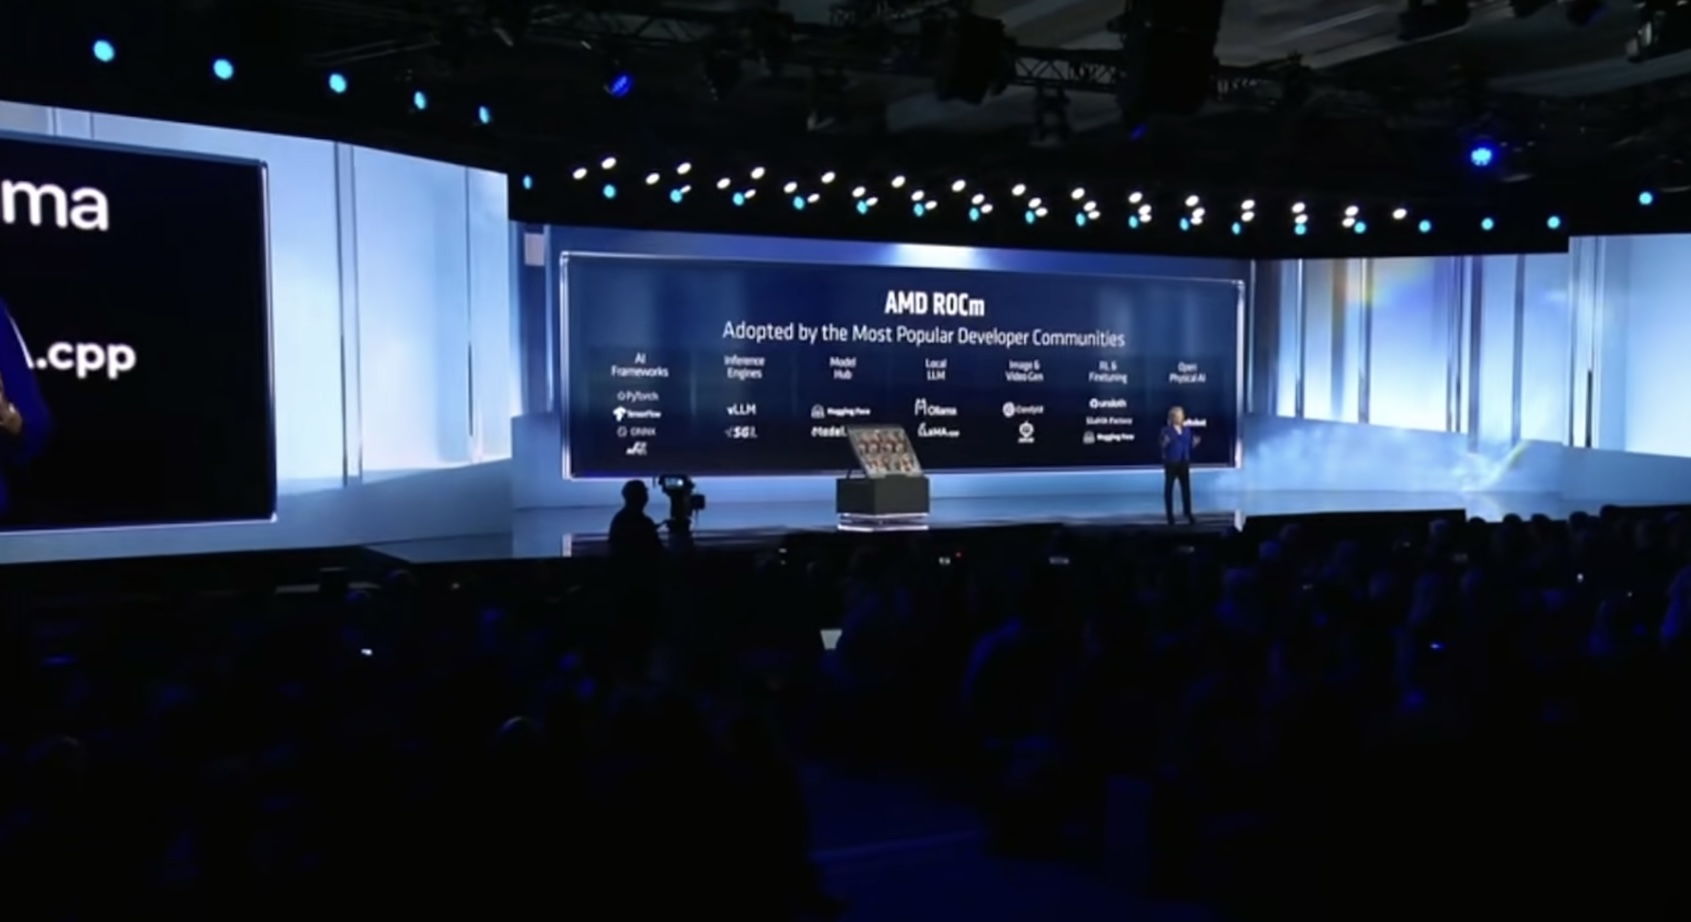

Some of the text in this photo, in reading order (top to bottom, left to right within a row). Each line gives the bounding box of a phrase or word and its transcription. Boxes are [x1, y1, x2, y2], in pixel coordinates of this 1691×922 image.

[884, 290, 985, 316] AMD ROCm
[722, 320, 1125, 348] Adopted by the Most Popular Developer Communities
[634, 352, 646, 364] AI
[724, 354, 765, 366] Inference
[829, 356, 857, 367] Model
[925, 358, 947, 368] Local
[611, 365, 669, 377] Frameworks
[1008, 360, 1032, 371] Image
[1177, 361, 1198, 372] Open
[727, 367, 763, 380] Engines
[833, 369, 853, 379] Hub
[926, 370, 946, 380] LLM
[1005, 371, 1044, 382] Video Gen
[1088, 372, 1128, 384] Finetuning
[1168, 373, 1207, 384] Physical AI
[626, 391, 659, 402] PyTorch
[726, 404, 757, 415] vLLM
[927, 405, 957, 415] Ollama
